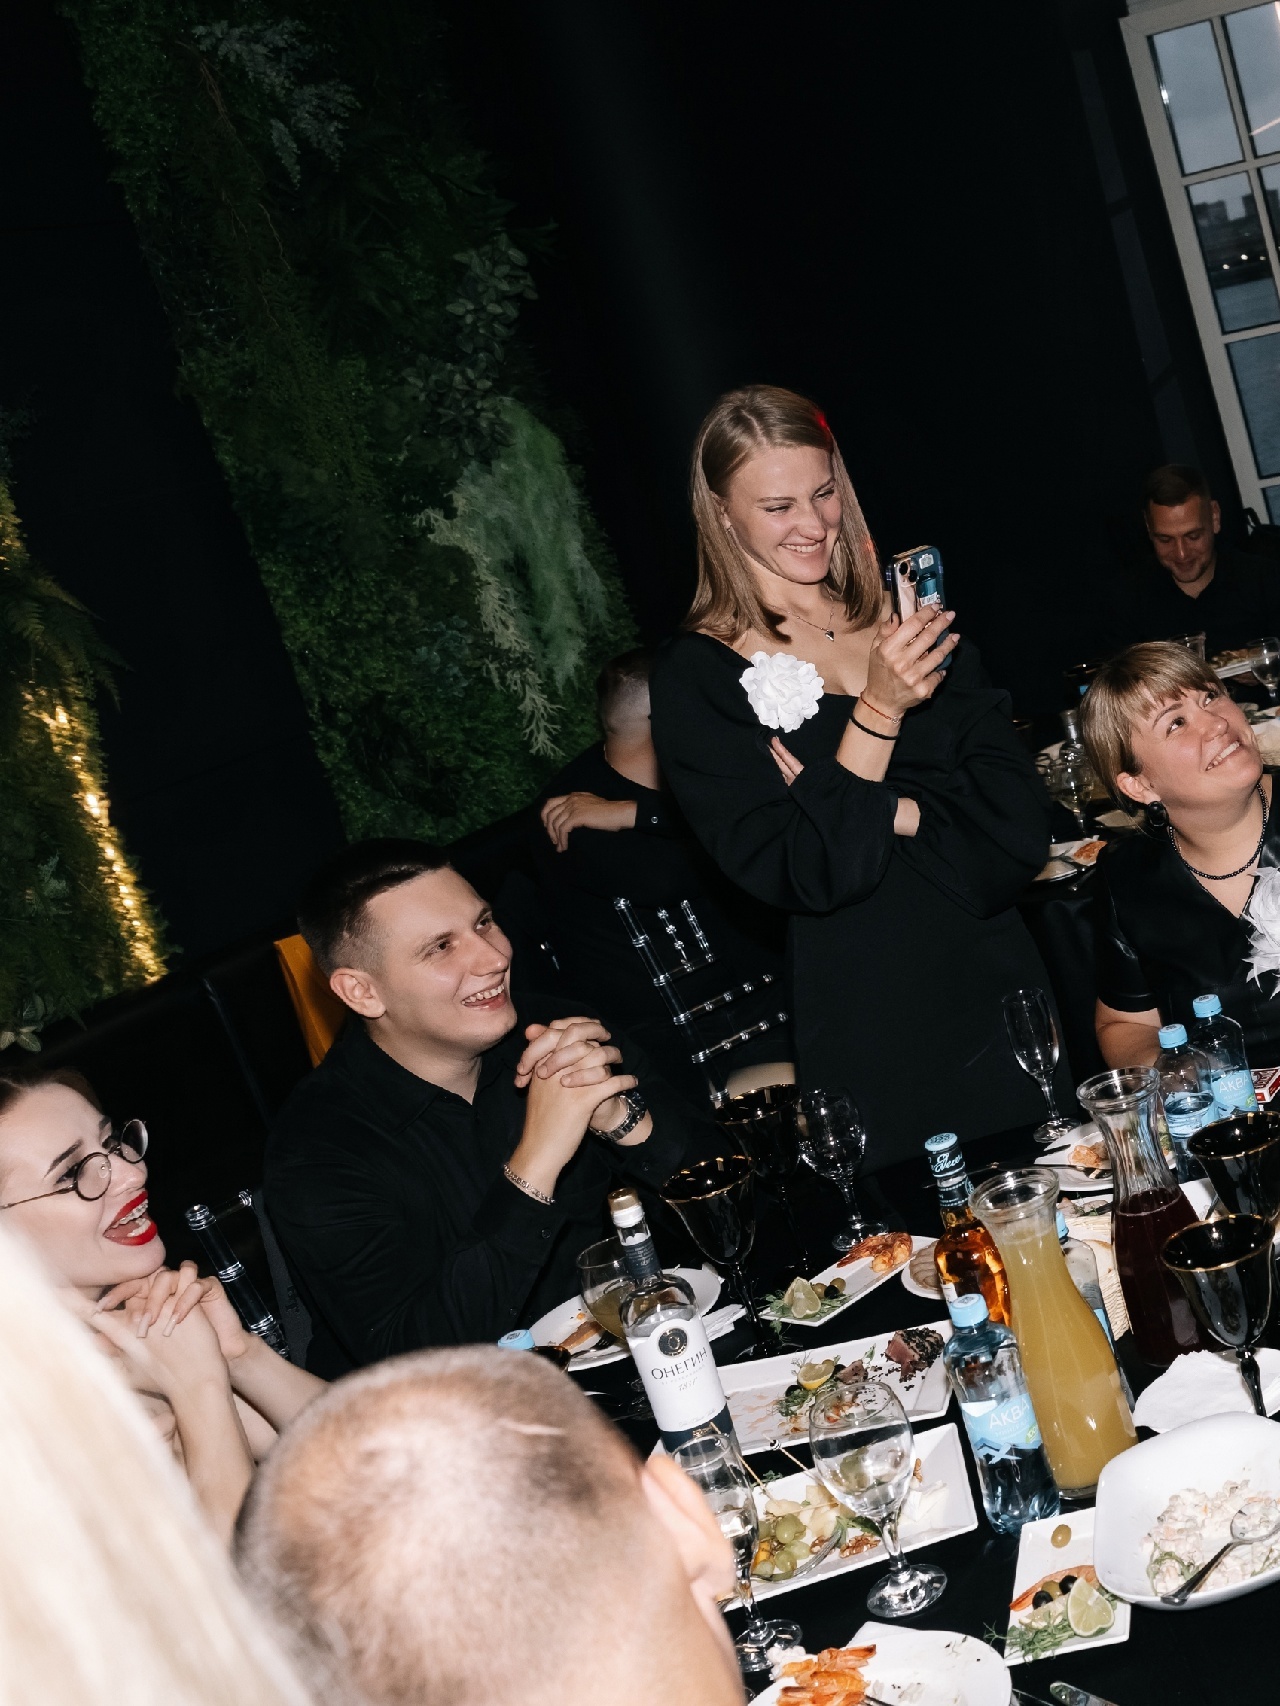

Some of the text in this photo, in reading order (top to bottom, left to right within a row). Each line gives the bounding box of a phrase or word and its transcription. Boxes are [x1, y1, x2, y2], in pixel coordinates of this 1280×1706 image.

[1220, 1072, 1248, 1093] АКВА
[651, 1347, 708, 1380] ОНЕГИН
[990, 1397, 1030, 1429] АКВА
